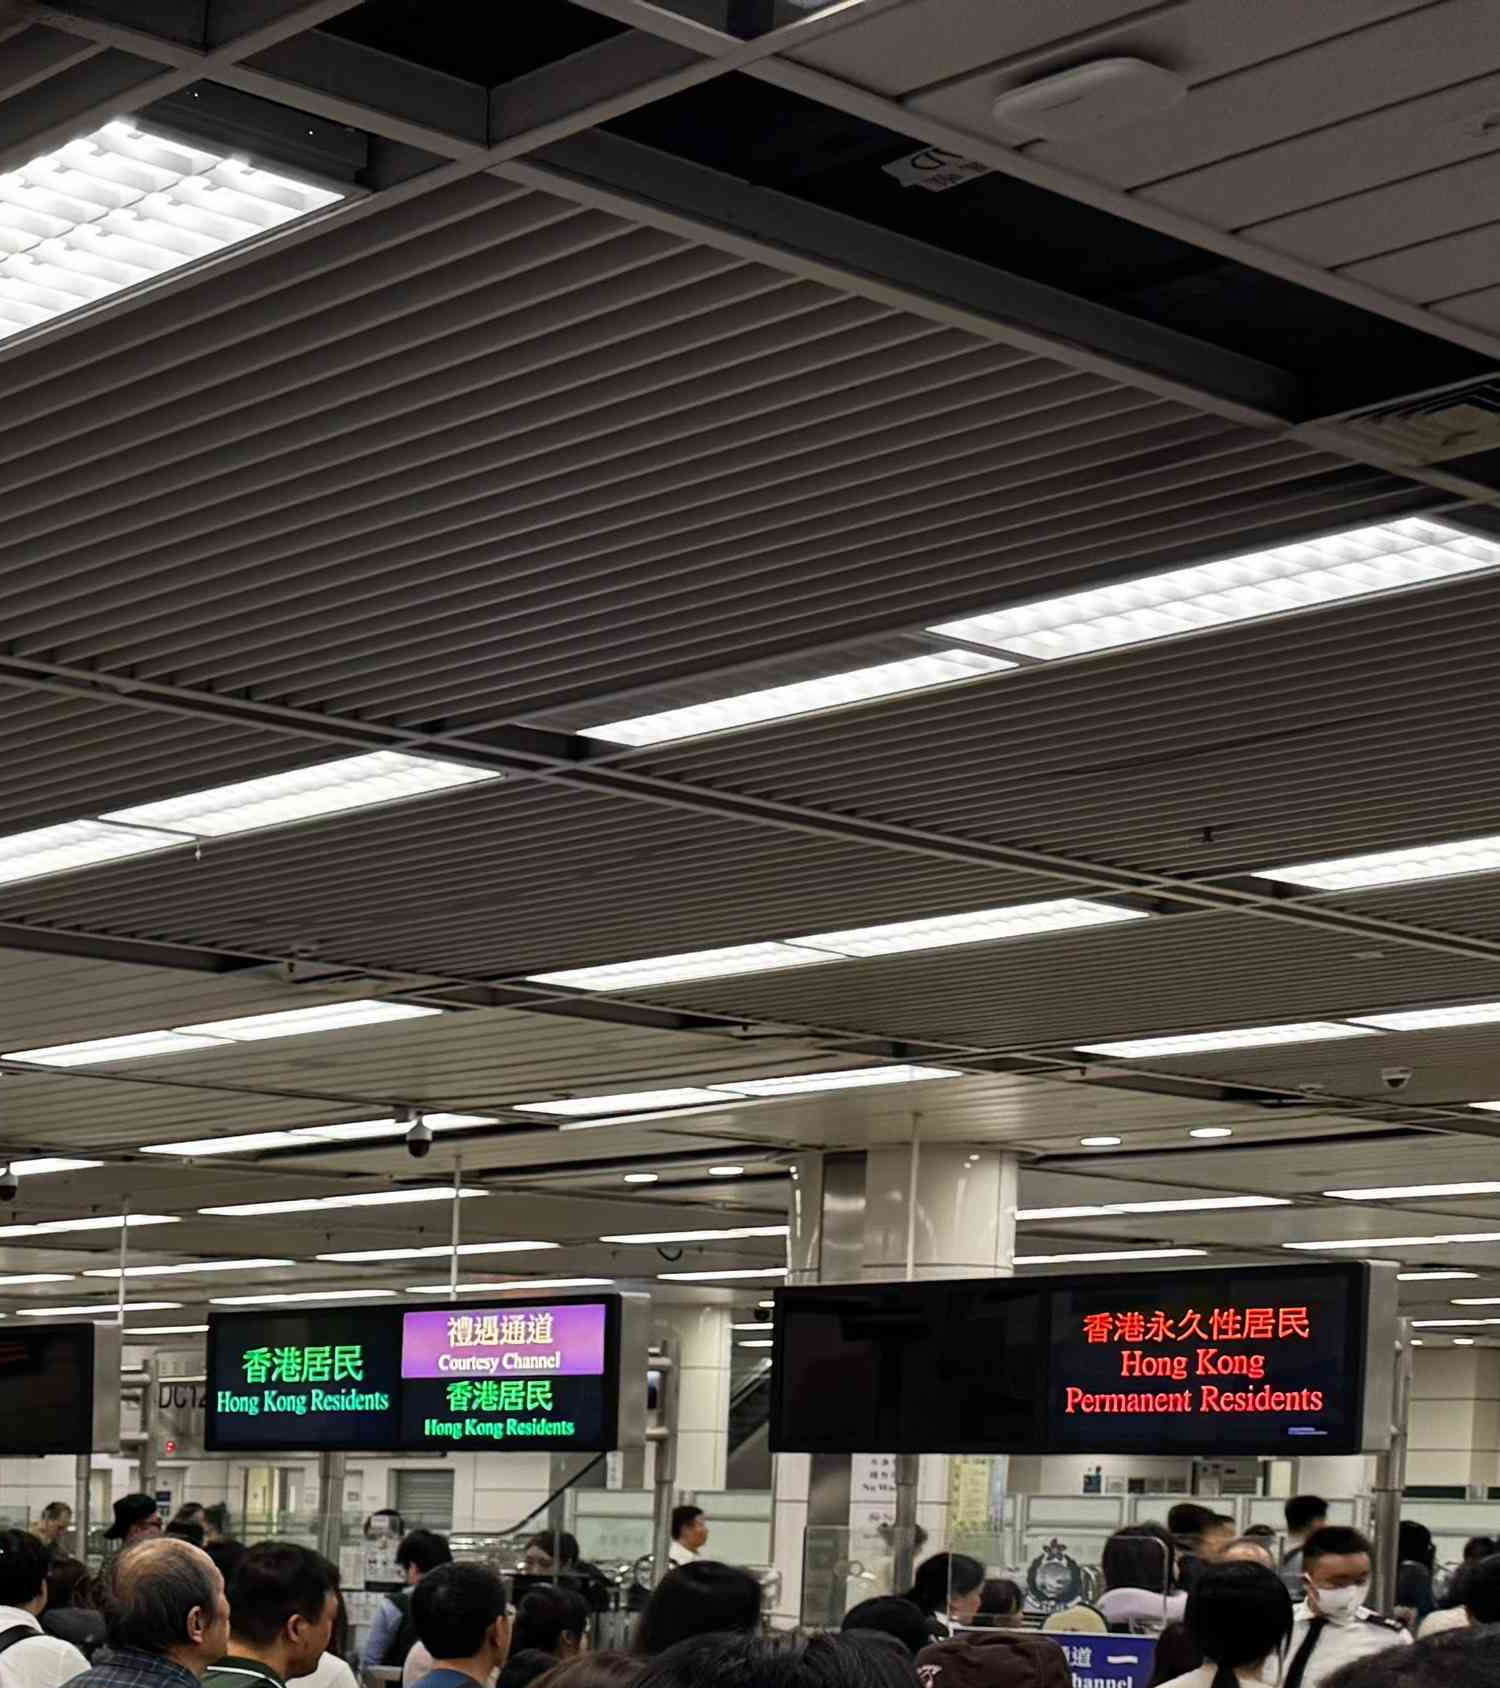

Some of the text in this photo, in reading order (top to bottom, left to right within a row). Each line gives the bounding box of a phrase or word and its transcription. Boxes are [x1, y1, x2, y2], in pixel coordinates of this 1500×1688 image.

[447, 1313, 553, 1347] 禮遇通道
[1083, 1307, 1310, 1343] 香港永久性居民
[242, 1345, 364, 1383] 香港居民
[438, 1352, 560, 1373] Courtesy Channel
[1121, 1349, 1264, 1379] Hong Kong
[217, 1388, 389, 1416] Hong Kong Residents
[446, 1380, 553, 1411] 香港居民
[1065, 1385, 1323, 1413] Permanent Residents
[425, 1418, 575, 1439] Hong Kong Residents
